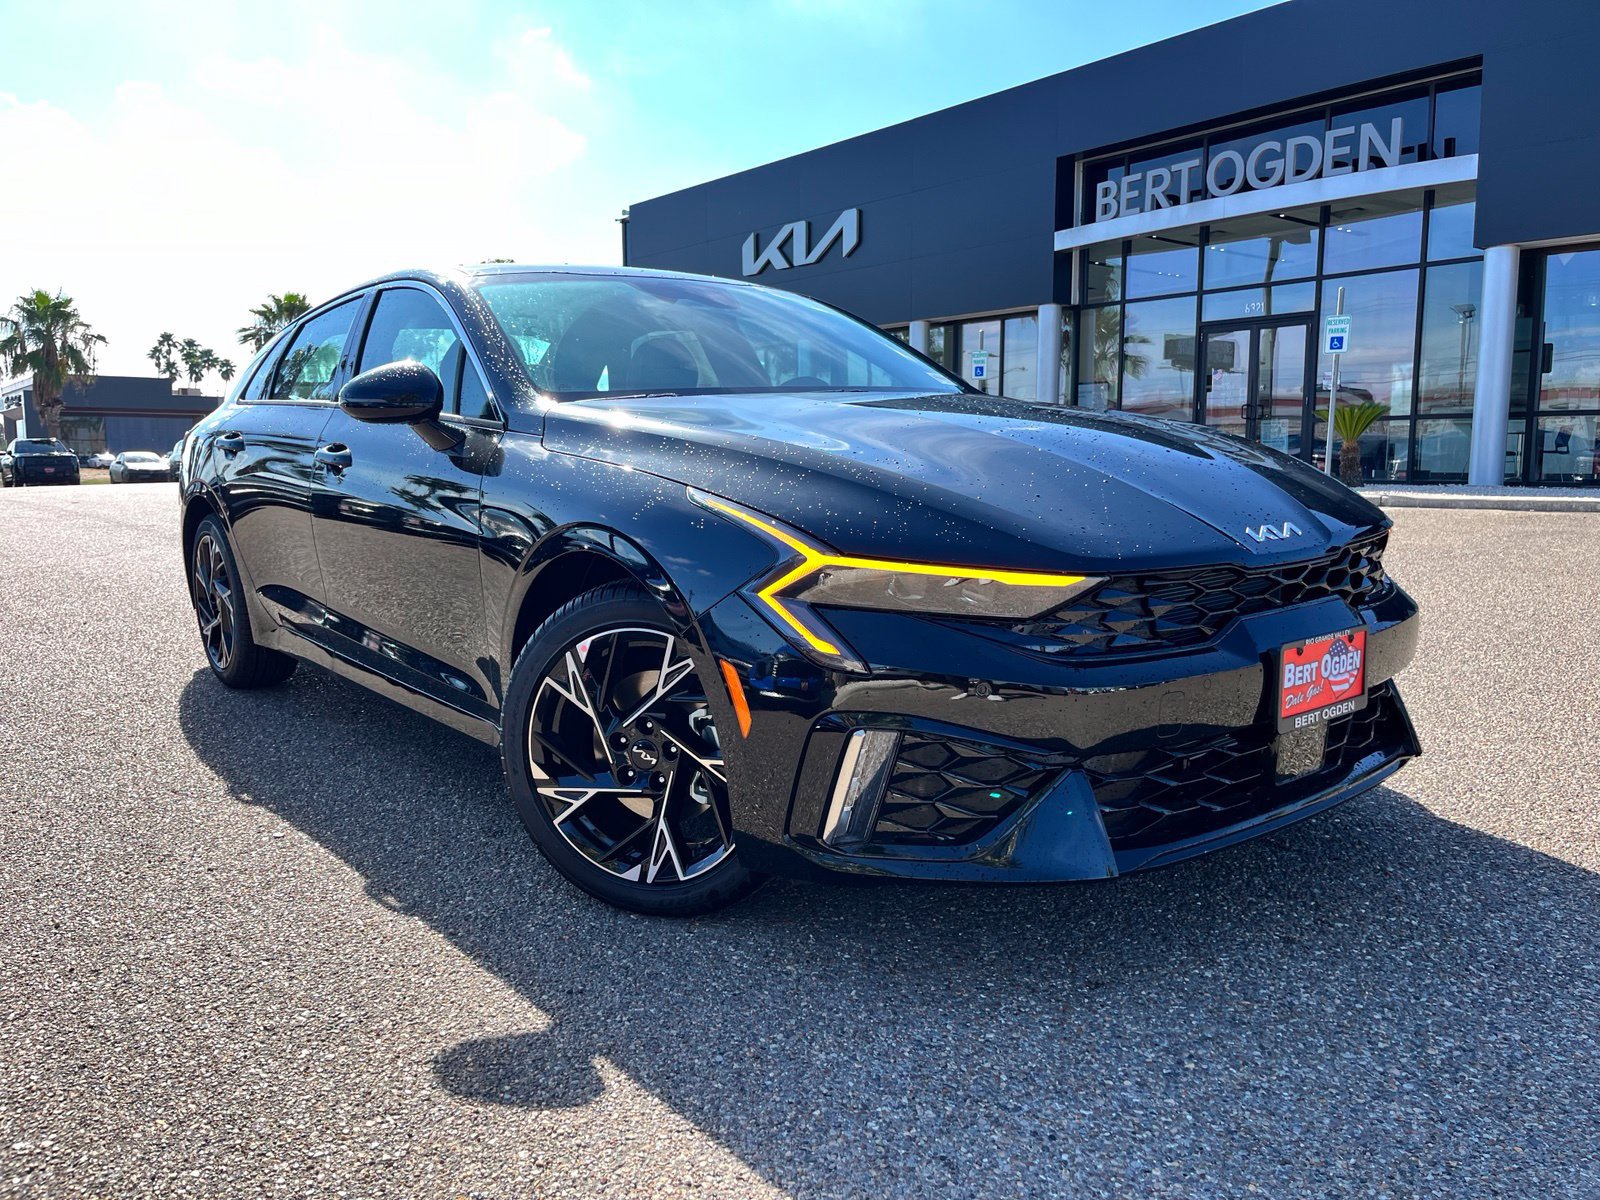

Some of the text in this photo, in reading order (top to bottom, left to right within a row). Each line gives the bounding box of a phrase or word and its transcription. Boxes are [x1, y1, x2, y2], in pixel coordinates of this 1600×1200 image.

[1095, 117, 1402, 223] BERT OGDEN
[741, 208, 860, 276] KIA
[1245, 521, 1302, 542] KIA
[1305, 629, 1351, 646] RIO GRANDE VALLEY
[1283, 650, 1361, 689] BERT OGDEN
[1295, 700, 1355, 728] BERT OGDEN
